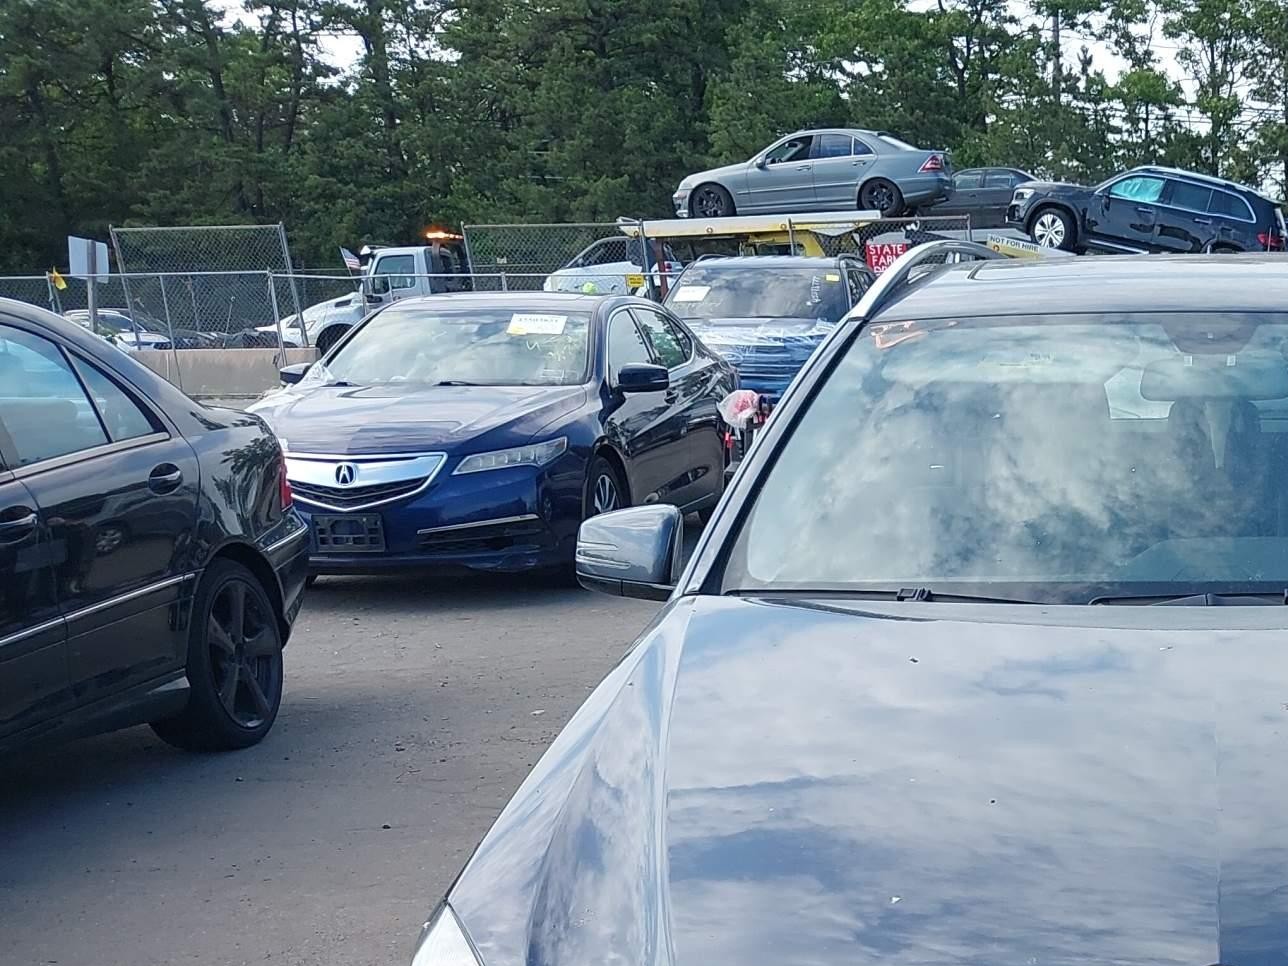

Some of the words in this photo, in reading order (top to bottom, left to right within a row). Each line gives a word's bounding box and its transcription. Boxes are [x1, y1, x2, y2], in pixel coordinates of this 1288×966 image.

[990, 235, 1005, 244] NOT
[1006, 239, 1021, 248] FOR
[869, 244, 903, 255] STATE
